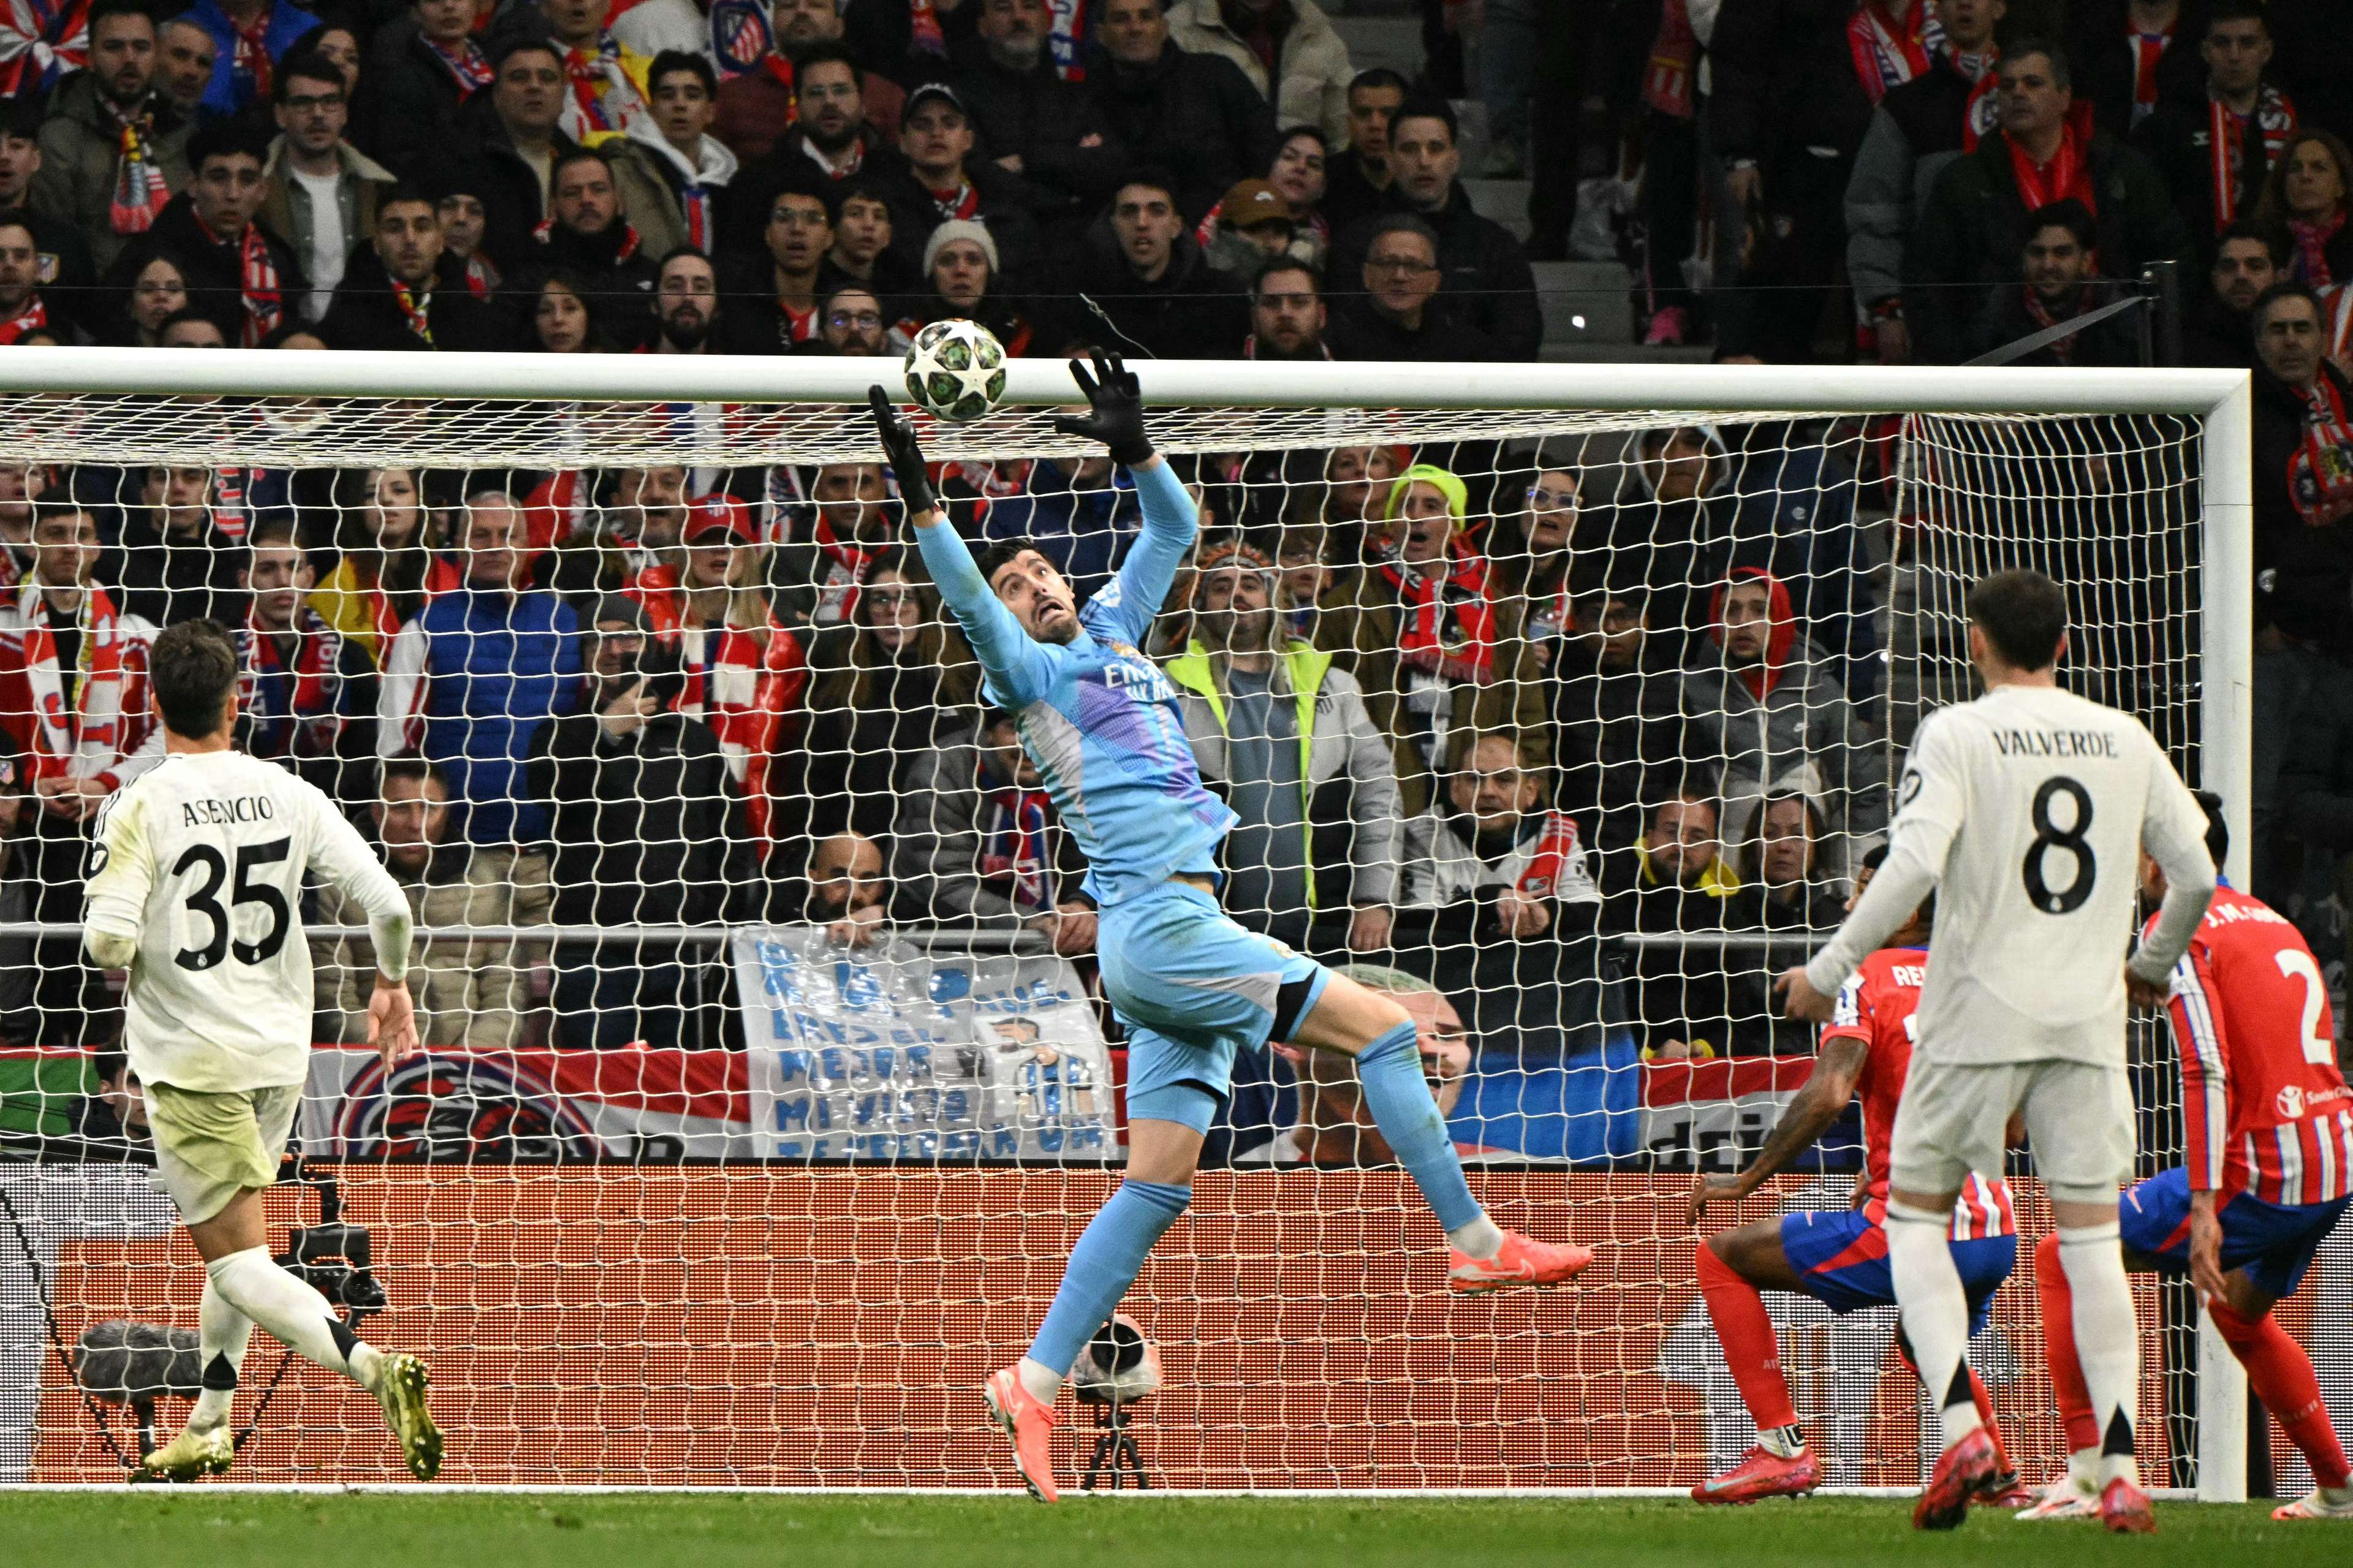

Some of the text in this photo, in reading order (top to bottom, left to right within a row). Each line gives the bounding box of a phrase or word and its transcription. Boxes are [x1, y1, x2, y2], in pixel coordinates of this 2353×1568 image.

[1992, 729, 2119, 759] VALVERDE
[182, 796, 273, 827] ASENCIO
[2023, 775, 2096, 915] 8
[172, 835, 292, 972] 35
[2274, 948, 2334, 1066] 2
[779, 1043, 932, 1082] MEJOR
[776, 1097, 830, 1131] MI
